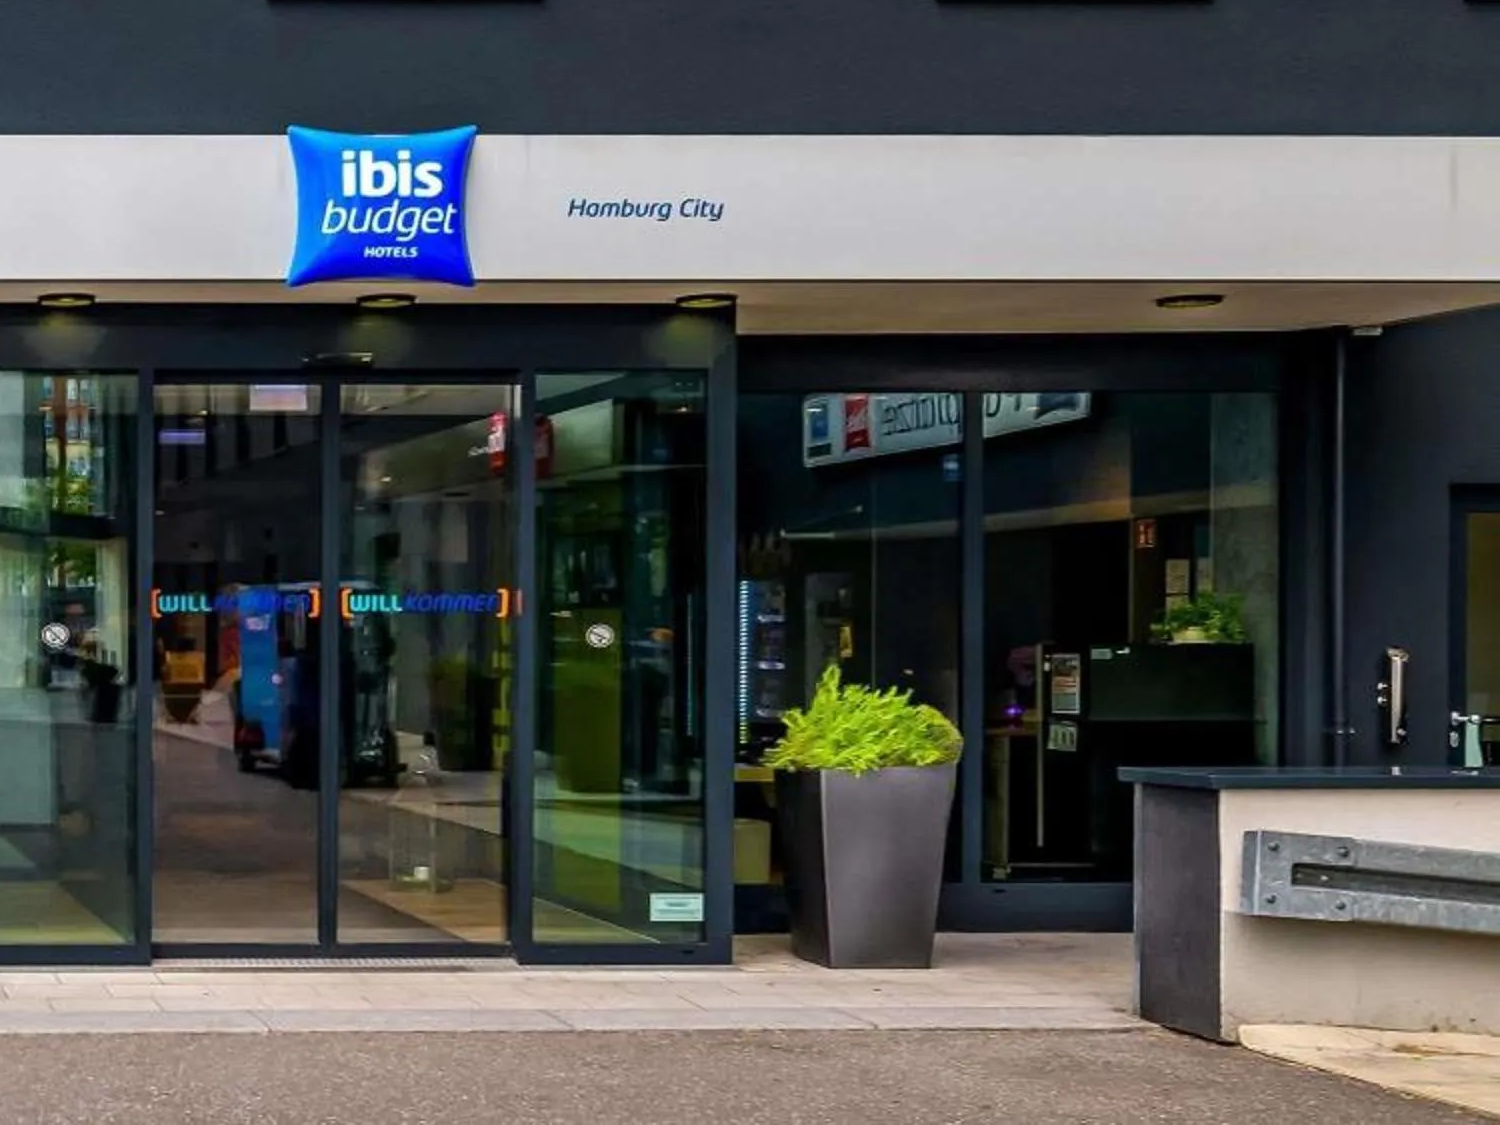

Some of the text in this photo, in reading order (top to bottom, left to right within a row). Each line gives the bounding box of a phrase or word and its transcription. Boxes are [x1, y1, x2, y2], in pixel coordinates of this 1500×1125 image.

[342, 150, 443, 198] ibis
[321, 198, 456, 242] budget
[567, 198, 725, 222] Hamburg City
[364, 246, 418, 258] HOTELS
